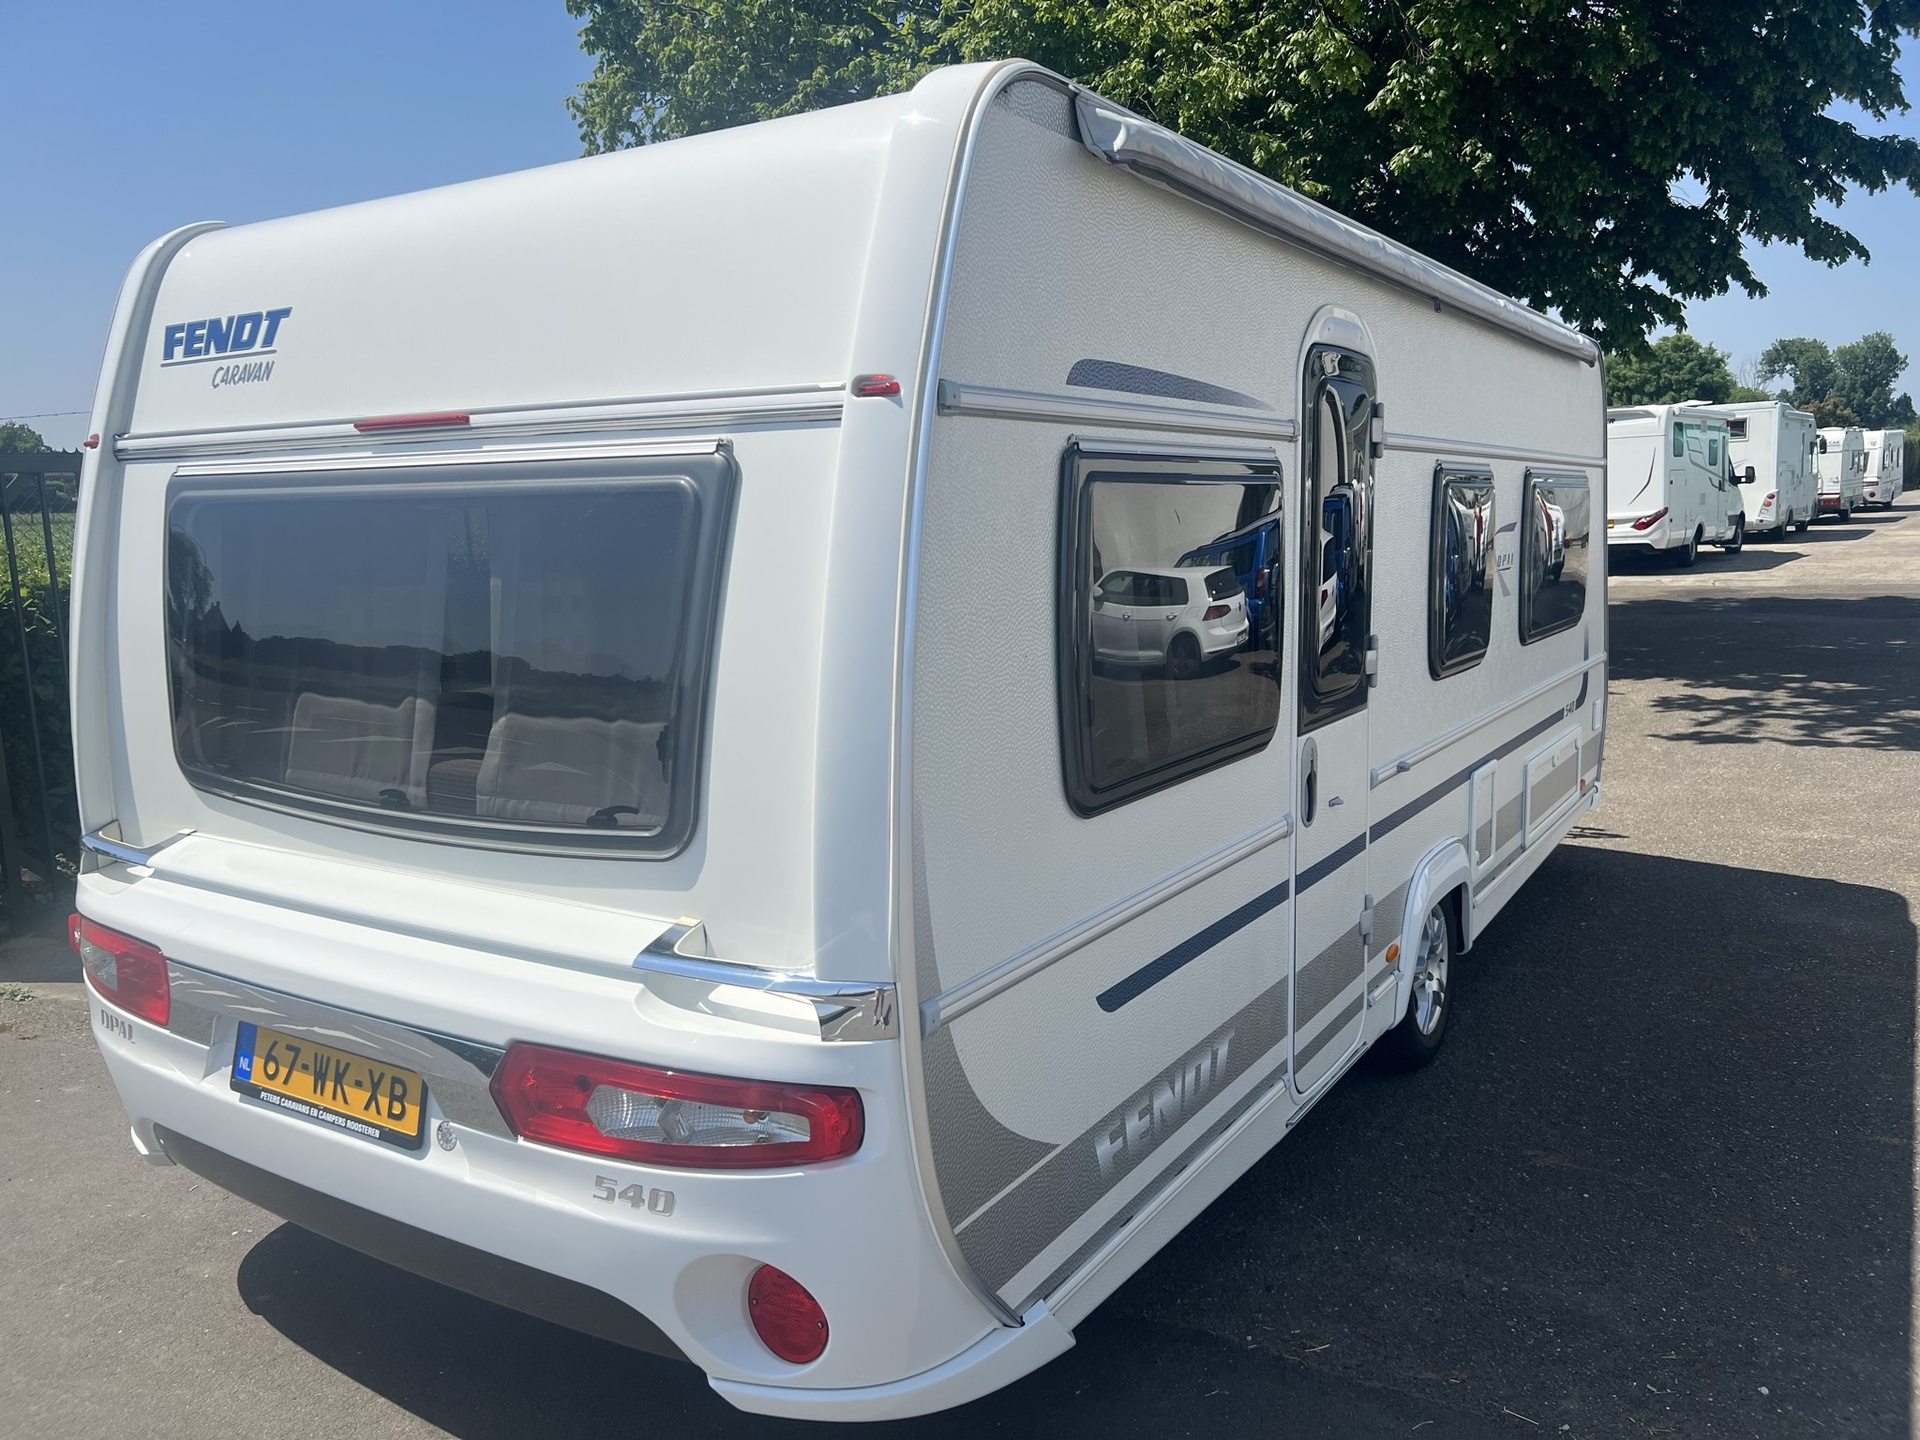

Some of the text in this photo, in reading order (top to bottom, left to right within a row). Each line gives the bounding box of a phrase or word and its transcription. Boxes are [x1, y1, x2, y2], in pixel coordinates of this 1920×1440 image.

[163, 307, 293, 361] FENDT
[212, 361, 275, 389] CARAVAN
[101, 1009, 136, 1045] OPAL
[239, 1039, 408, 1122] NL 67-WK-XB
[1095, 1028, 1235, 1178] FENDT
[260, 1091, 381, 1139] PETERS CARAVANS EN CAMPERS ROOSTEREN
[592, 1174, 676, 1218] 540
